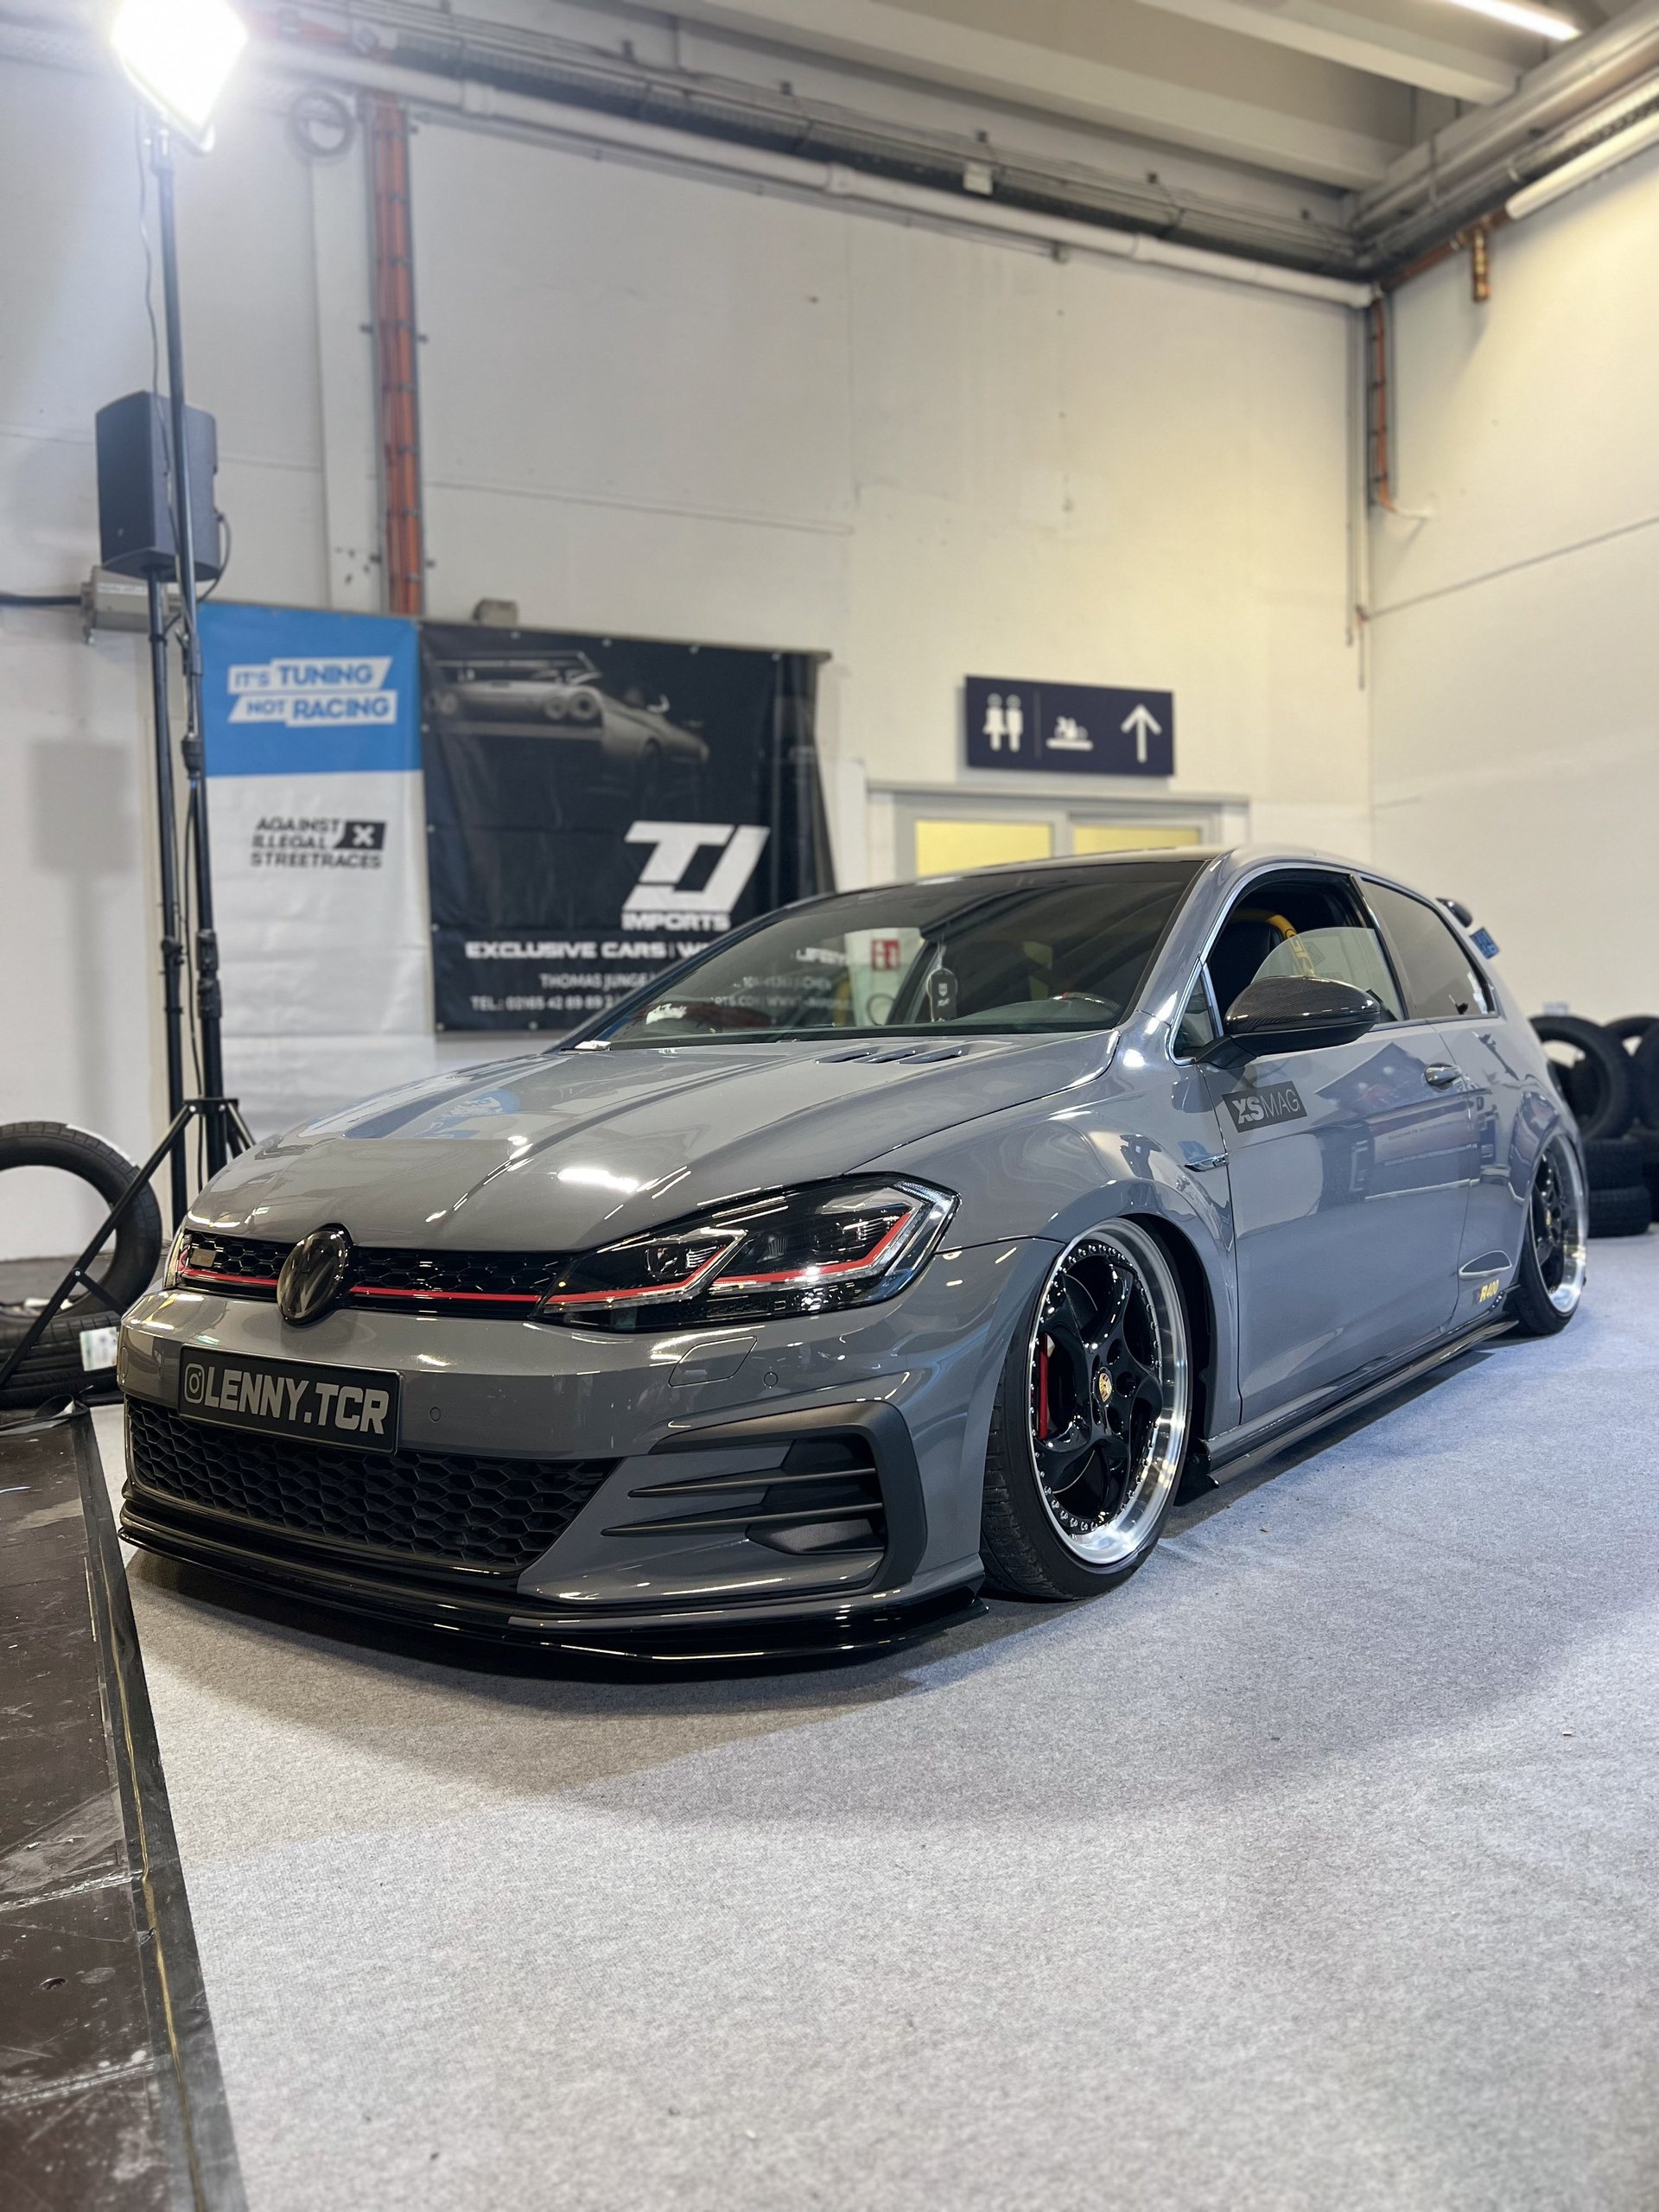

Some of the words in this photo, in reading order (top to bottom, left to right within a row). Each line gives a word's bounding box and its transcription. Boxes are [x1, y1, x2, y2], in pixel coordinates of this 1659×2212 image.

[234, 671, 270, 688] IT'S
[277, 664, 373, 685] TUNING
[246, 699, 287, 715] NOT
[292, 696, 389, 719] RACING
[257, 817, 340, 833] AGAINST
[251, 834, 326, 849] ILLEGAL
[251, 851, 382, 869] STREETRACES
[621, 912, 731, 932] IMPORTS
[465, 941, 597, 959] EXCLUSIVE
[601, 941, 667, 959] CARS
[539, 973, 602, 989] THOMAS
[204, 1366, 390, 1435] LENNY.TCR
